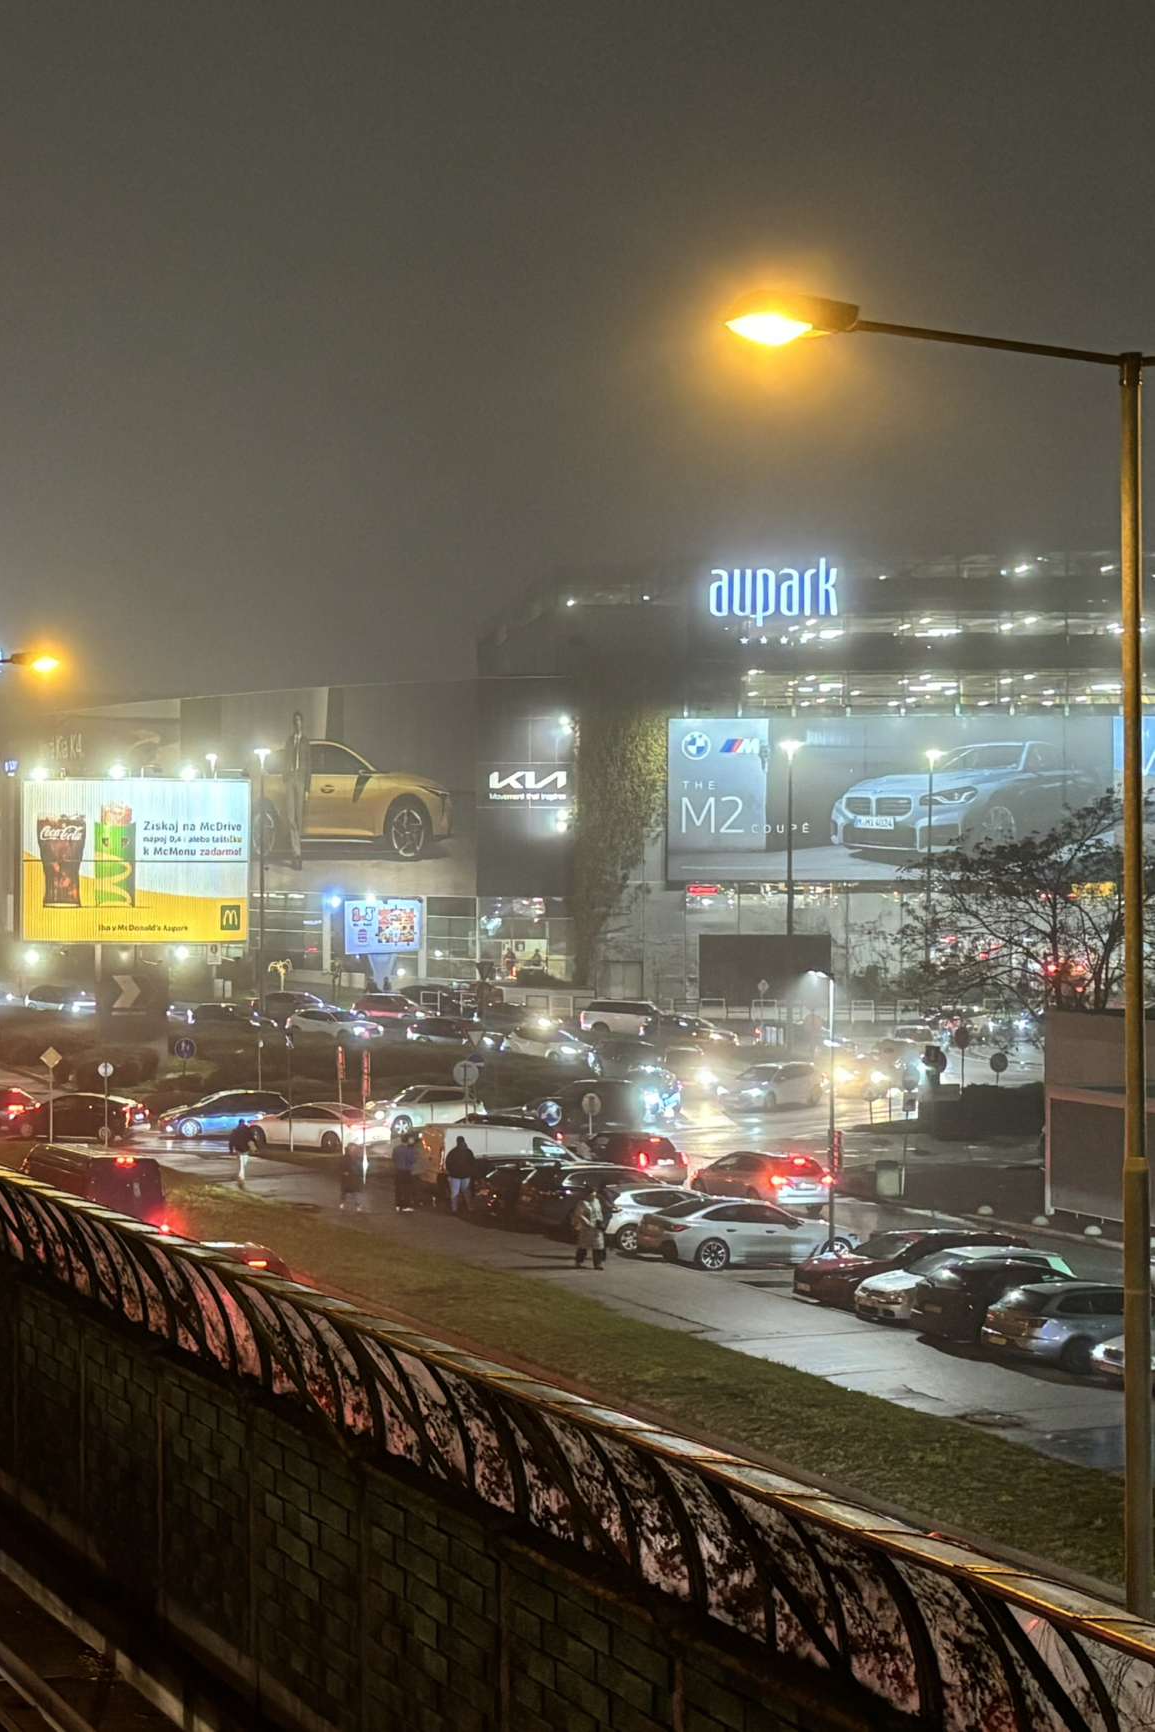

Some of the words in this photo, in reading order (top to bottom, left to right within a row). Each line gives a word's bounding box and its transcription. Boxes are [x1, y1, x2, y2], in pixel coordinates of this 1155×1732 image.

[709, 557, 838, 627] aupark
[489, 771, 567, 789] KIA
[682, 780, 716, 790] THE
[541, 793, 567, 801] inspires
[681, 796, 744, 834] M2
[183, 823, 196, 831] na
[200, 821, 242, 831] McDrive
[40, 825, 84, 840] Coca-Cola
[169, 835, 182, 843] 0,4
[188, 835, 210, 843] alebo
[143, 847, 150, 856] k
[153, 847, 197, 856] McMenu
[199, 847, 242, 856] zadarmo!
